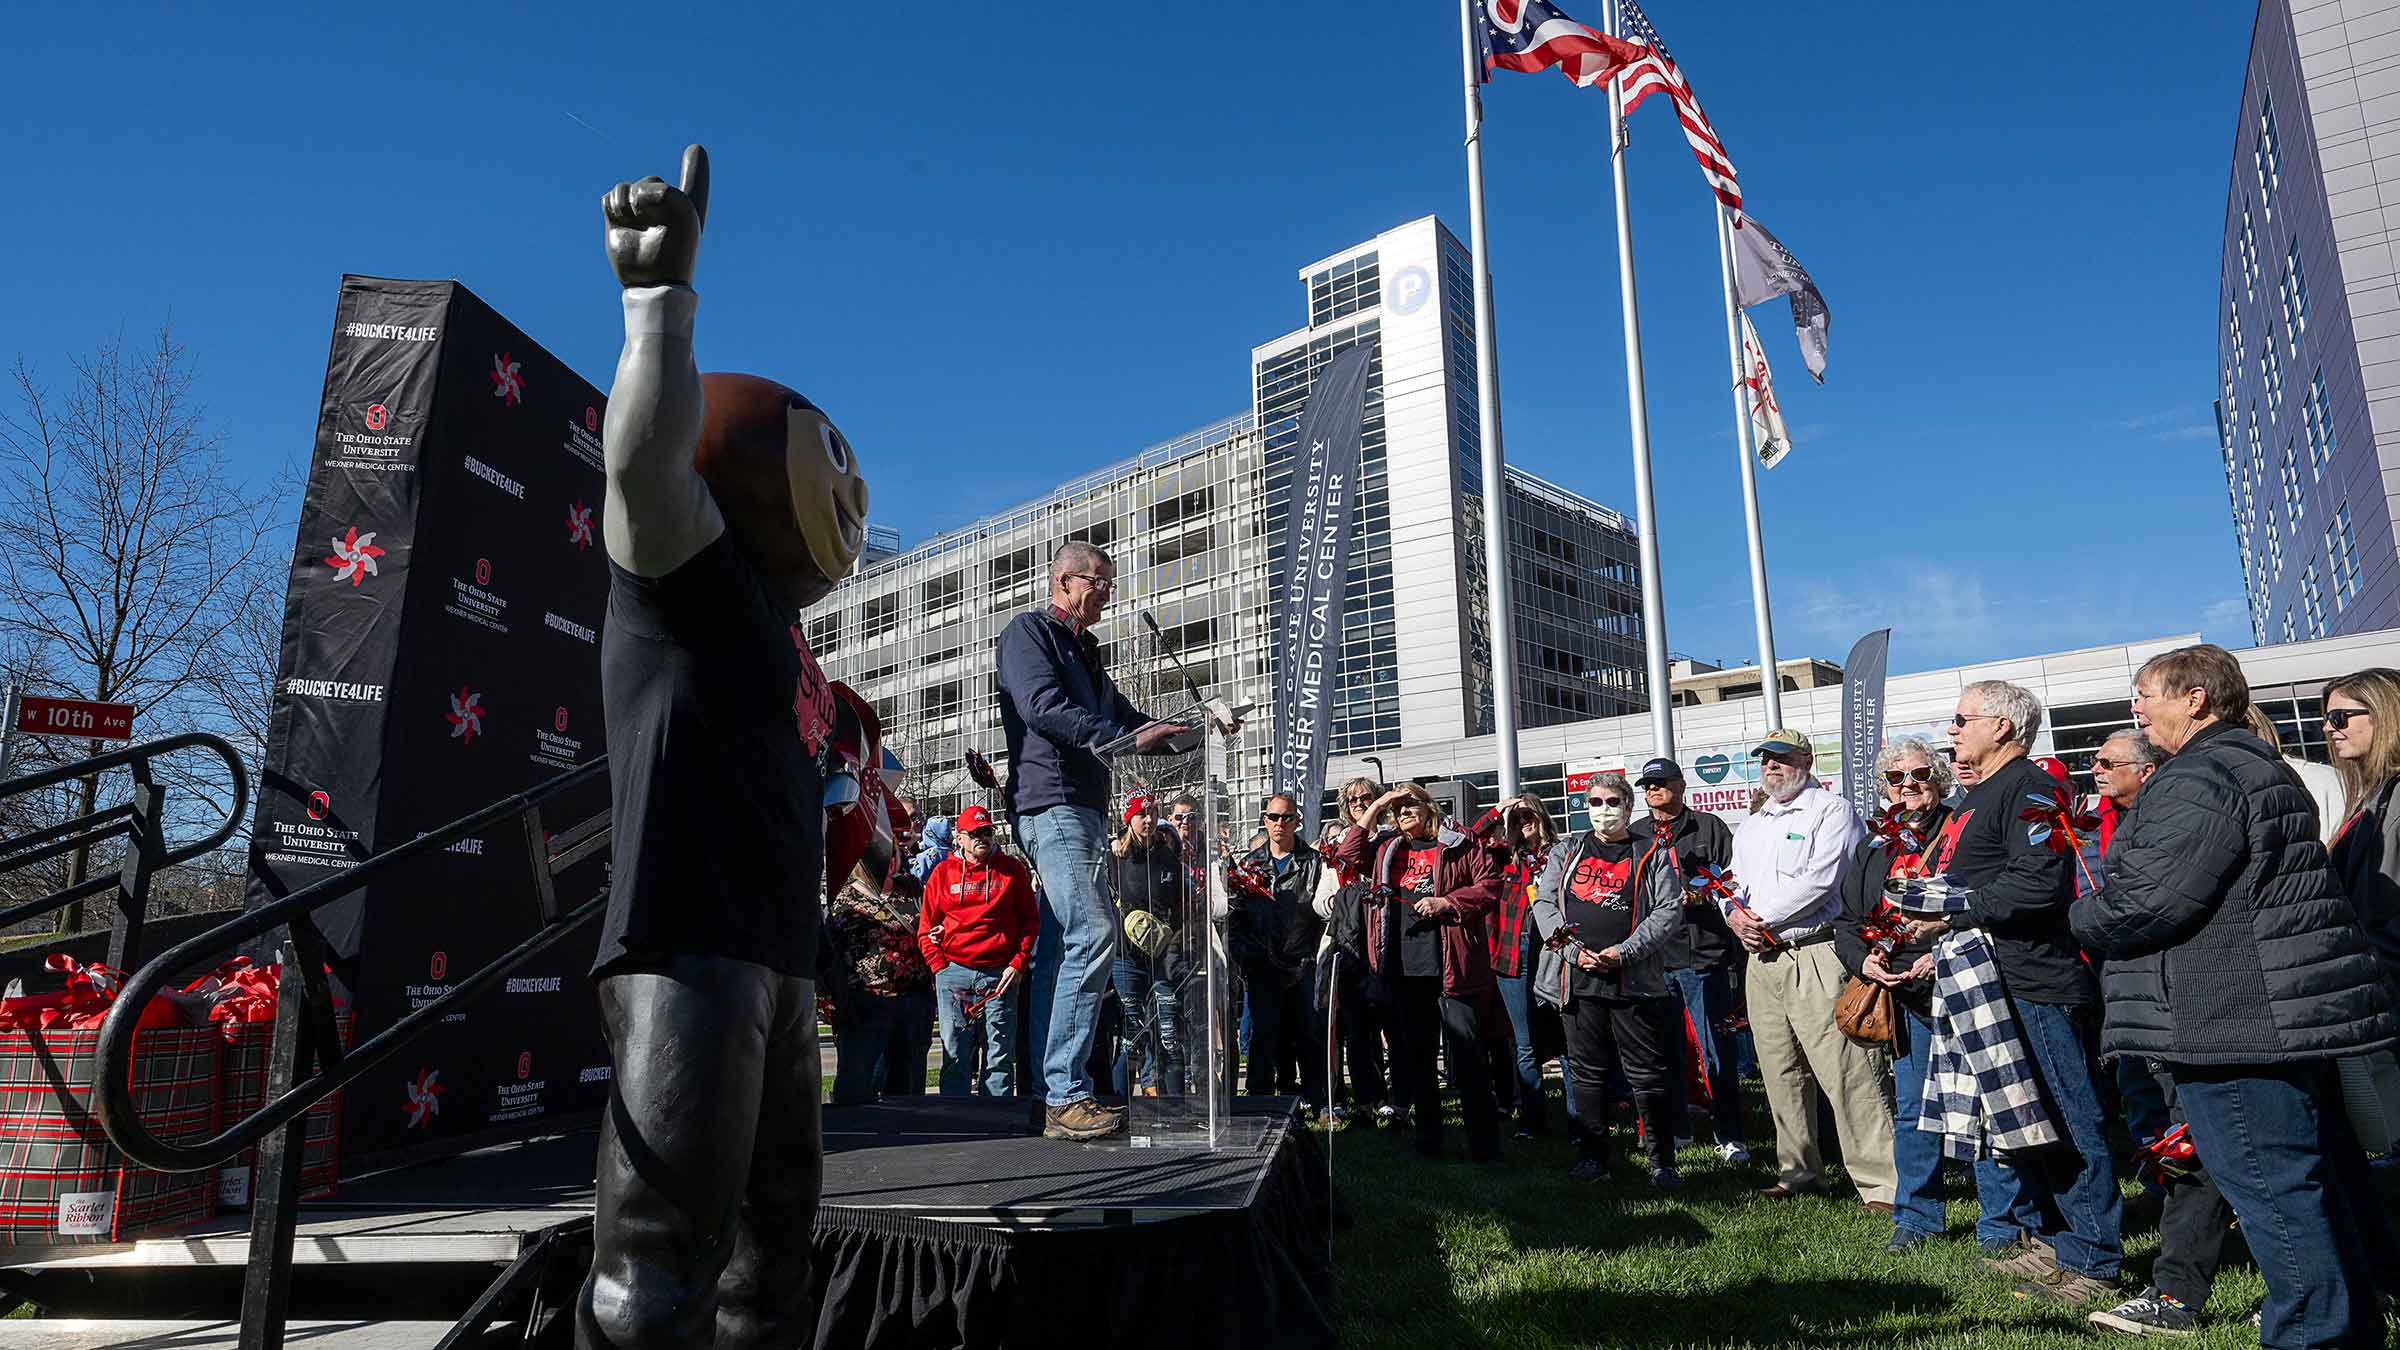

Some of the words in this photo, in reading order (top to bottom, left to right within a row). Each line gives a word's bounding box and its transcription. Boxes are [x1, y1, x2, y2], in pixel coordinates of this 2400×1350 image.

[346, 322, 437, 341] #BUCKEYE4LIFE
[336, 432, 355, 443] THE
[356, 433, 381, 445] OHIO
[383, 435, 412, 446] STATE
[343, 445, 400, 457] UNIVERSITY
[325, 460, 354, 469] WEXNER
[355, 462, 387, 471] MEDICAL
[388, 463, 416, 472] CENTER
[464, 455, 525, 500] #BUCKEYE4LIFE
[1289, 438, 1324, 605] UNIVERSITY
[453, 577, 468, 592] THE
[468, 585, 487, 600] OHIO
[487, 593, 507, 608] STATE
[1300, 588, 1330, 709] MEDICAL
[1317, 473, 1344, 580] CENTER
[458, 592, 501, 616] UNIVERSITY
[544, 611, 596, 644] #BUCKEYE4LIFE
[286, 678, 384, 701] #BUCKEYE4LIFE
[27, 709, 37, 720] W
[48, 707, 94, 729] 10th
[104, 716, 127, 728] Ave
[1852, 679, 1864, 769] UNIVERSITY
[1866, 698, 1876, 755] CENTER
[1854, 772, 1864, 816] STATE
[274, 821, 296, 833] THE
[297, 824, 325, 836] OHIO
[326, 827, 359, 840] STATE
[283, 835, 347, 852] UNIVERSITY
[265, 852, 296, 863] WEXNER
[297, 856, 330, 867] MEDICAL
[405, 985, 422, 996] THE
[422, 984, 443, 996] OHIO
[506, 977, 561, 992] #BUCKEYE4LIFE
[65, 1213, 104, 1222] Ribbon
[67, 1202, 105, 1213] Scarlet
